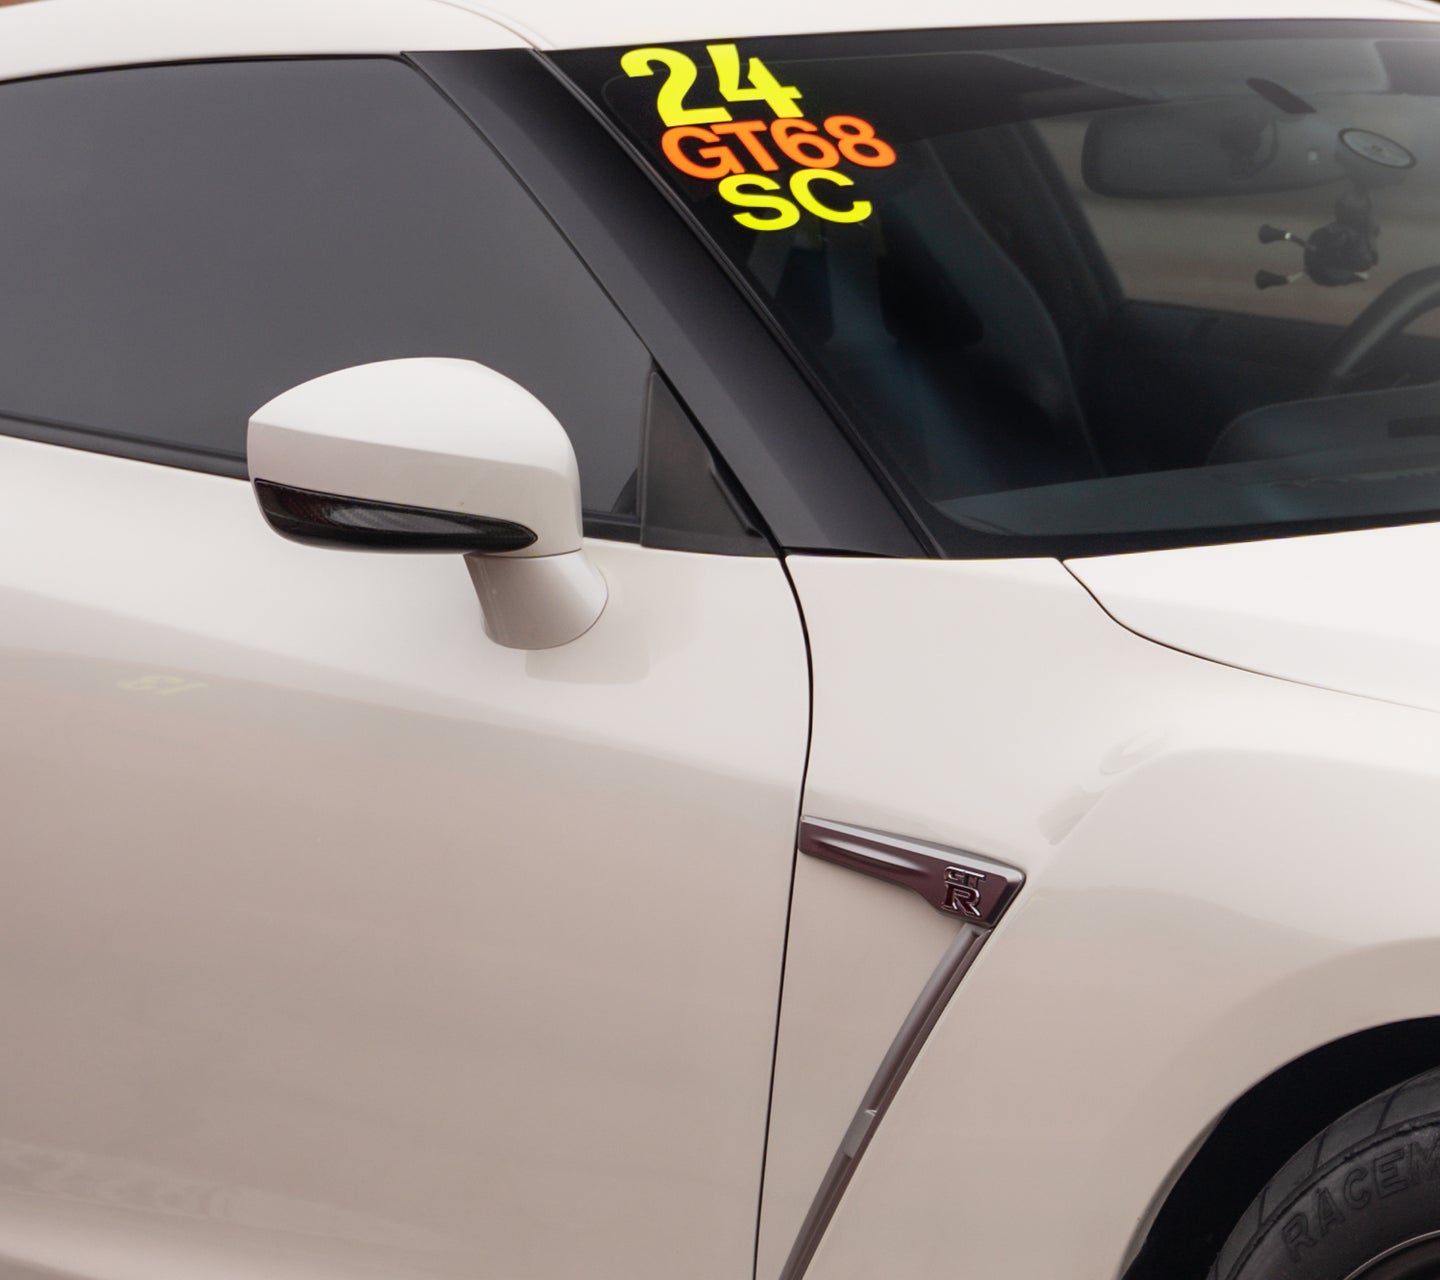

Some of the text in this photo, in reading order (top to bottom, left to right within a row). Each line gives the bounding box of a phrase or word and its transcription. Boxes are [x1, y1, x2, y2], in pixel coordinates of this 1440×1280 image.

[620, 43, 804, 127] 24
[661, 115, 897, 180] GT68
[718, 168, 872, 231] SC
